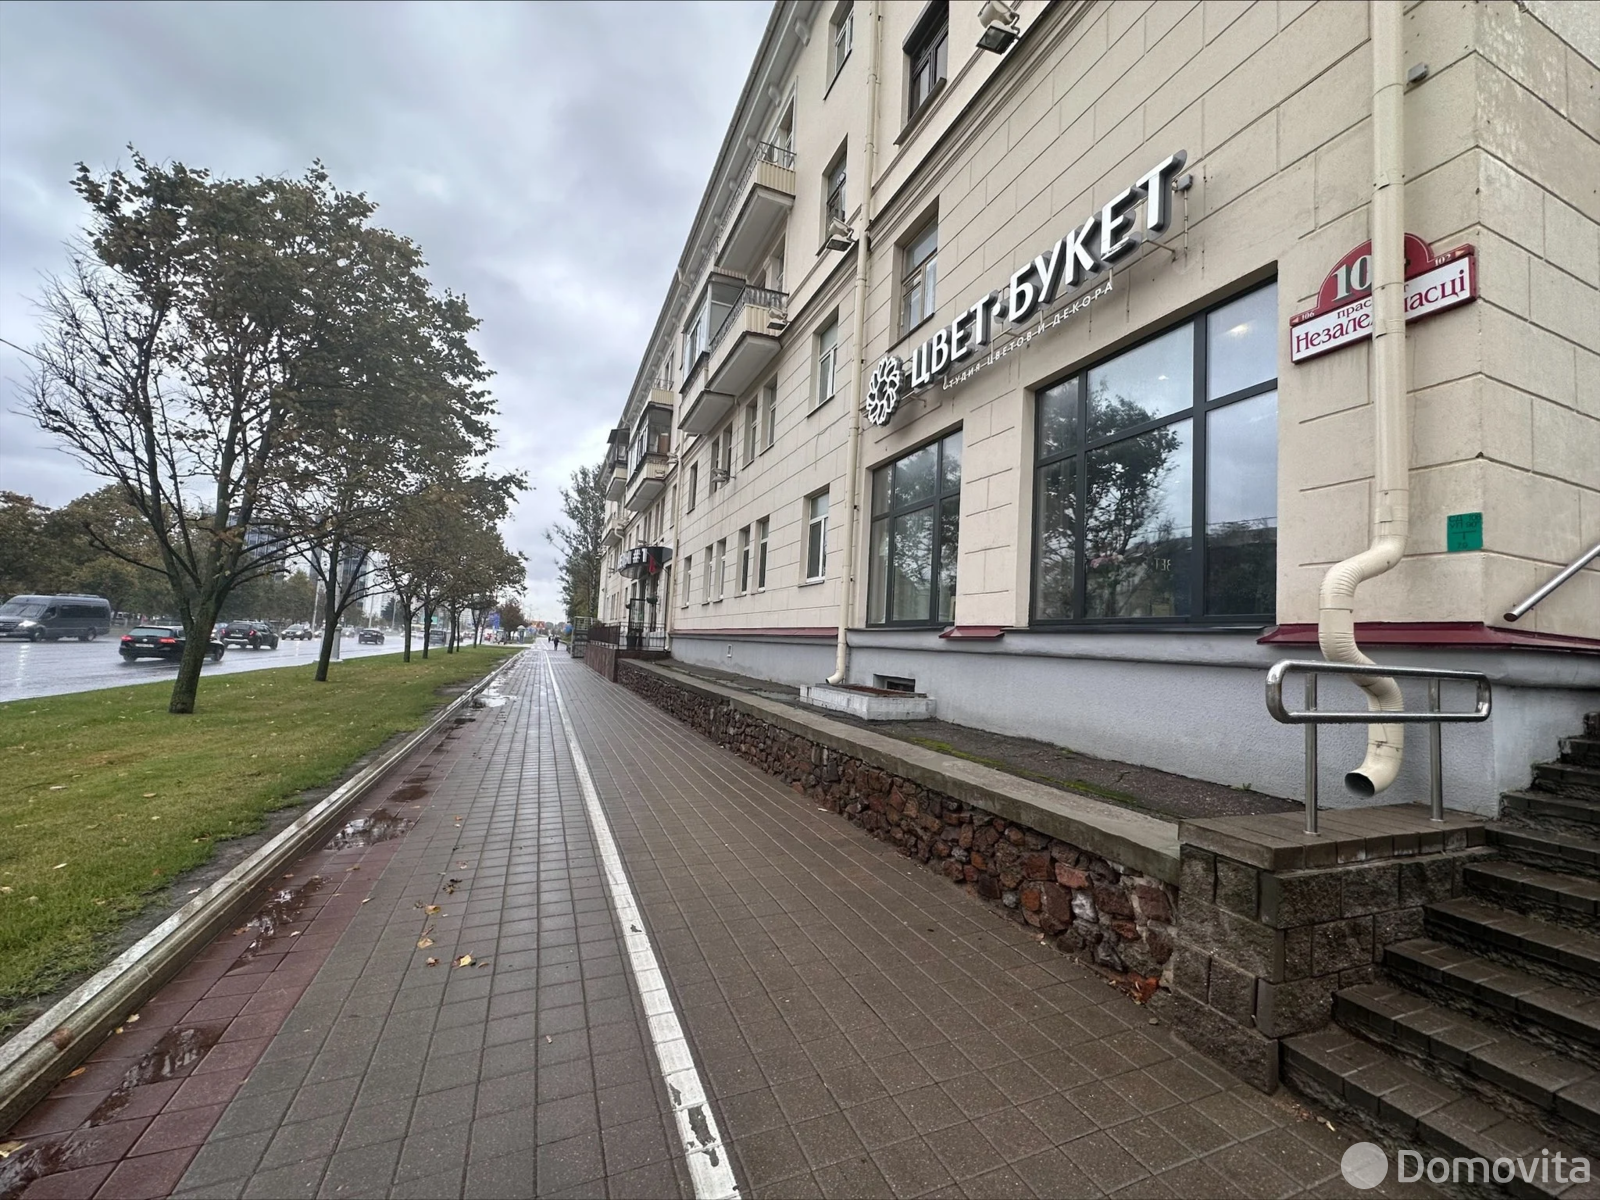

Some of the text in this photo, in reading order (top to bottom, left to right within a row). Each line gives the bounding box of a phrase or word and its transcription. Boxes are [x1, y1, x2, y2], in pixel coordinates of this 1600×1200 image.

[987, 331, 1032, 366] ЦВЕТОВ
[1052, 281, 1113, 328] ДЕКОРА
[1295, 269, 1466, 354] Незалеасці
